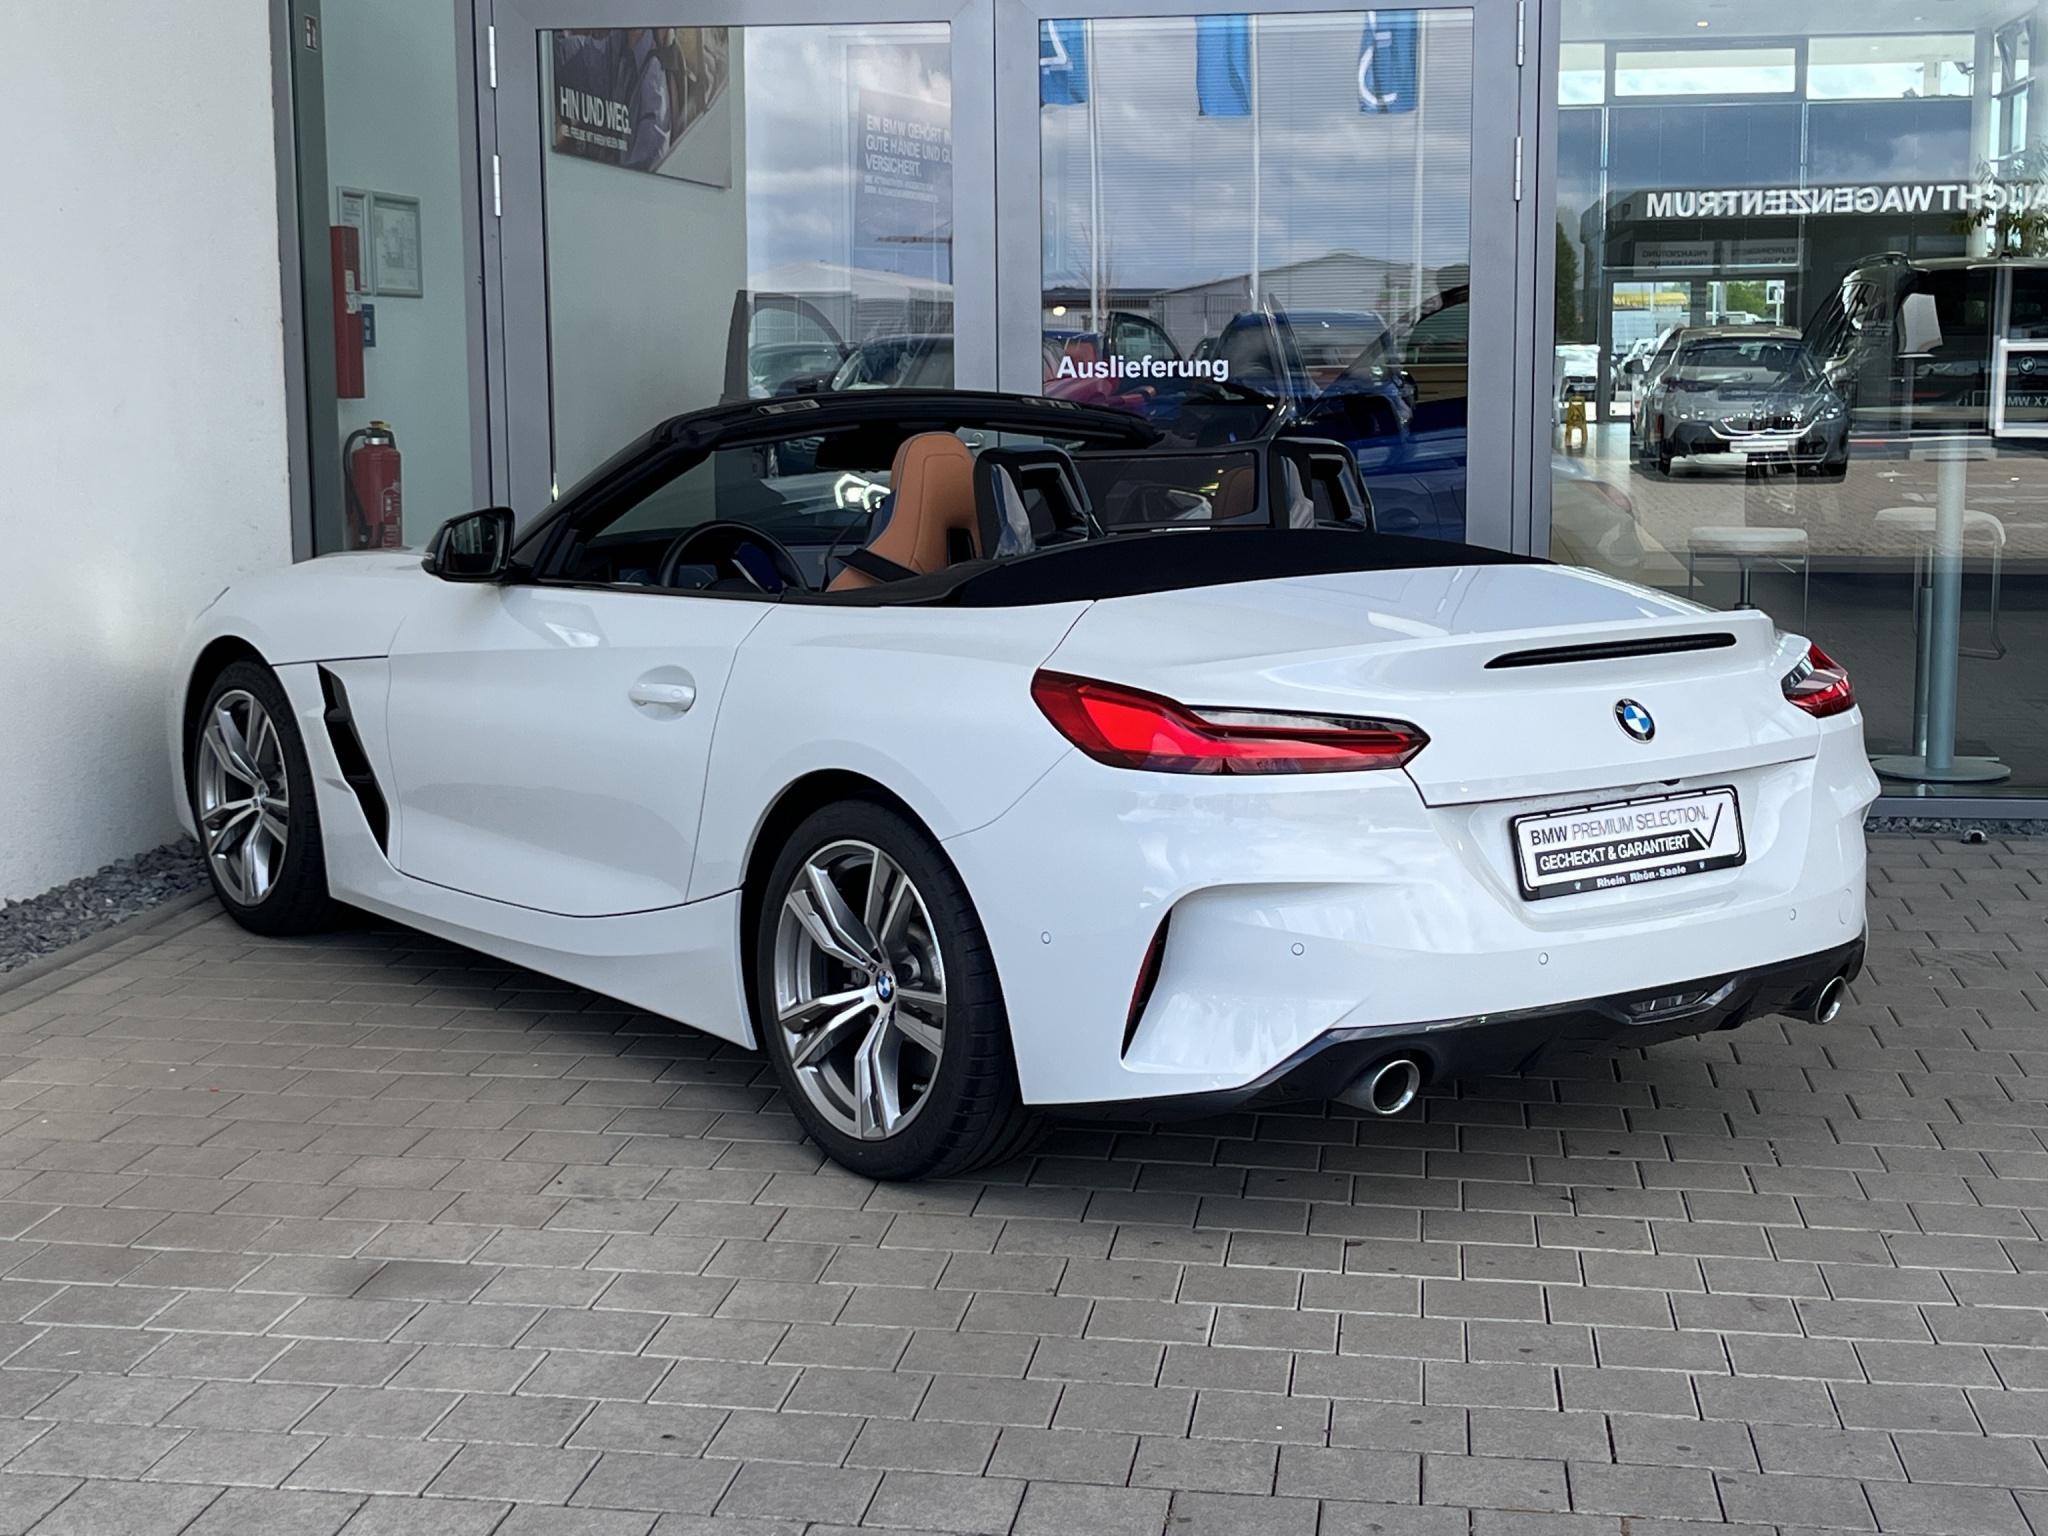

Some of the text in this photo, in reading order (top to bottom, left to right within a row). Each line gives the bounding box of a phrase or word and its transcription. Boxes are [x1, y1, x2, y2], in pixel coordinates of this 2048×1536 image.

[560, 86, 632, 134] HIN UND WEG.
[866, 114, 880, 131] EIN
[882, 117, 906, 137] BMW
[865, 134, 888, 152] GUTE
[921, 143, 940, 162] UND
[1056, 355, 1230, 382] Auslieferung
[2007, 396, 2030, 406] MW
[1530, 825, 1568, 846] BMW
[1571, 815, 1635, 841] PREMIUM
[1539, 833, 1691, 871] GECHECKT & GARANTIERT
[1596, 874, 1627, 888] Rhein
